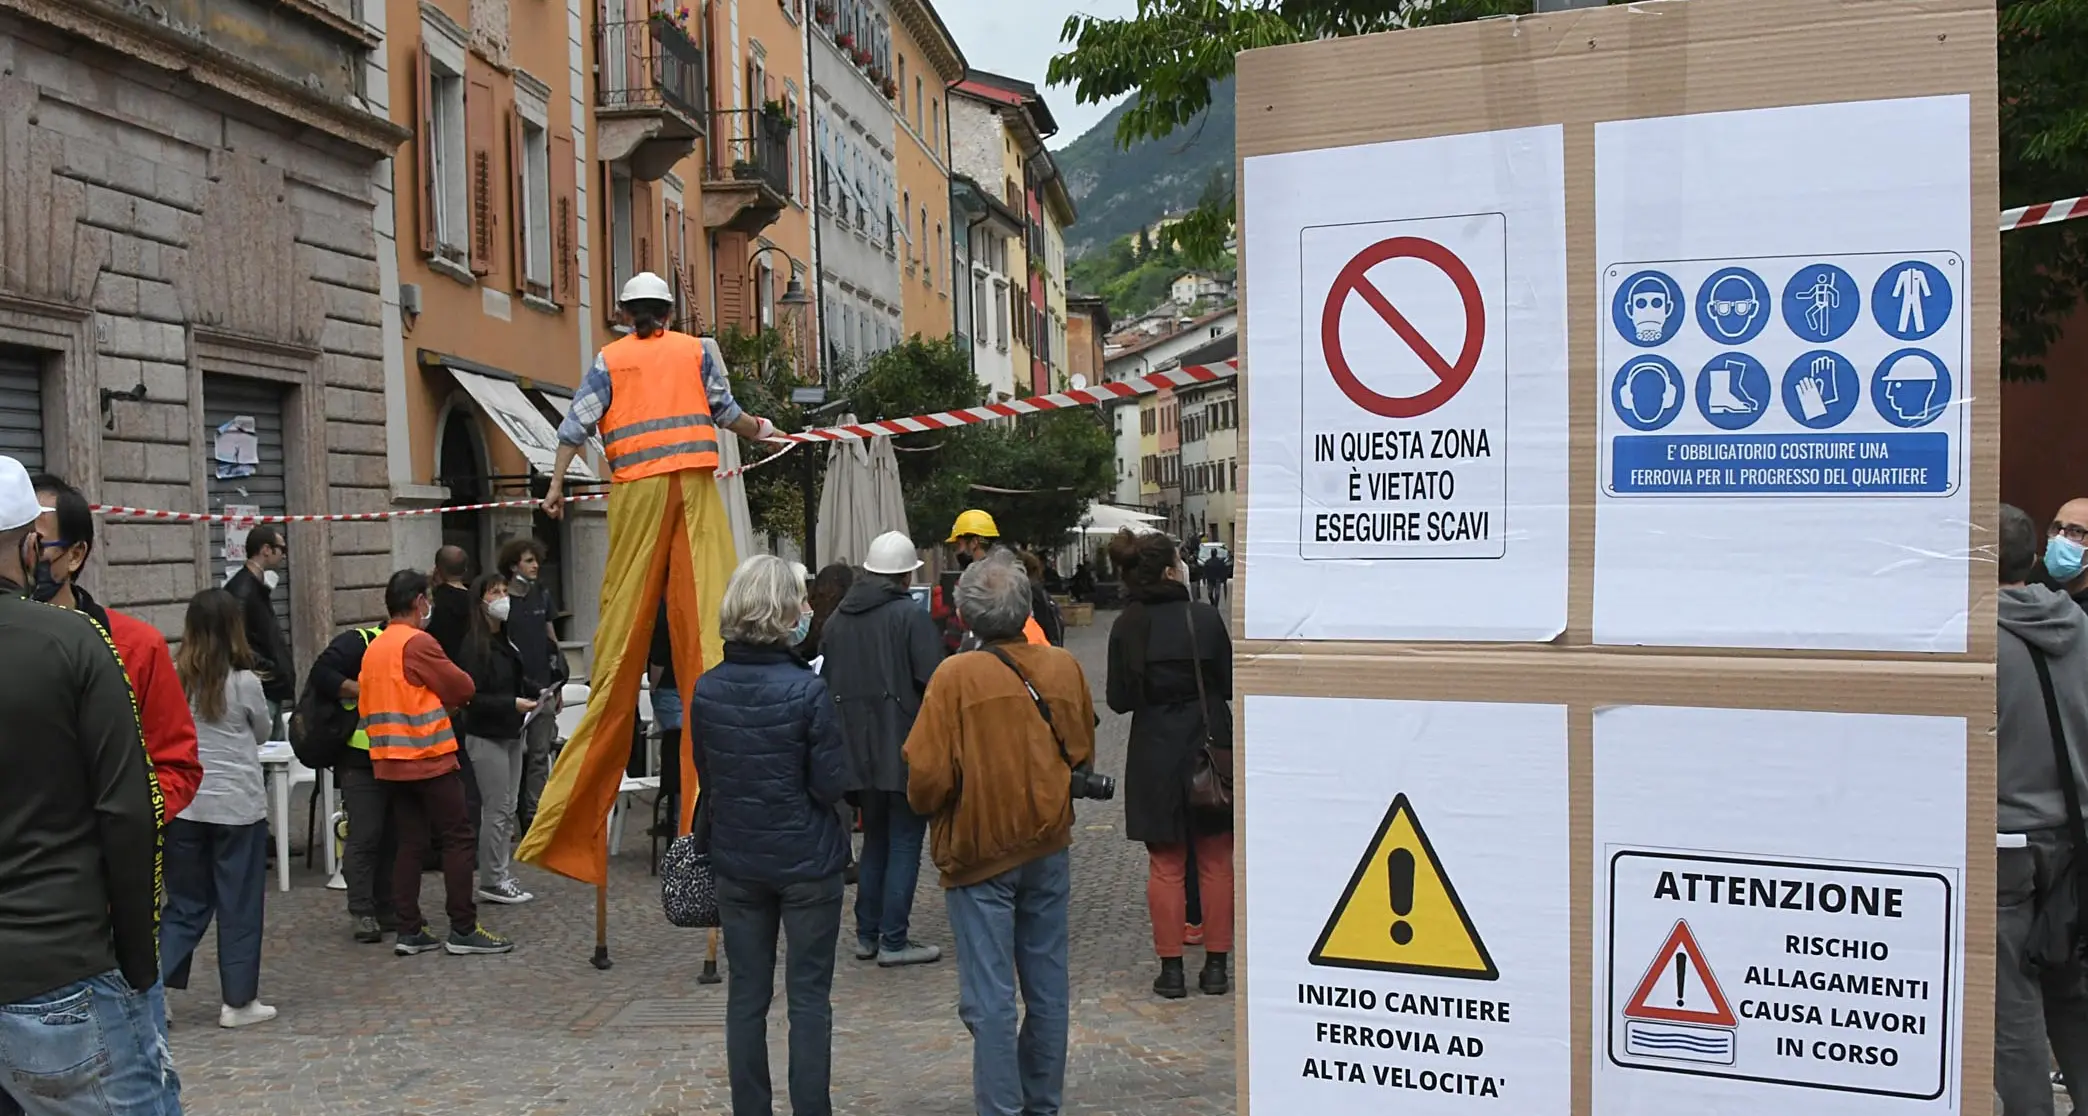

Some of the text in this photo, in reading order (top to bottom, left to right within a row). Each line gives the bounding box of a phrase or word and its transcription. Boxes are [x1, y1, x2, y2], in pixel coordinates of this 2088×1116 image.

[1316, 429, 1490, 462] IN QUESTA ZONA
[1668, 443, 1888, 460] E' OBBLIGATORIO COSTRUIRE UNA
[1350, 467, 1454, 501] È VIETATO
[1632, 468, 1927, 486] FERROVIA PER IL PROGRESSO DEL QUARTIERE
[1316, 512, 1488, 541] ESEGUIRE SCAVI
[1654, 870, 1904, 918] ATTENZIONE
[1786, 935, 1888, 960] RISCHIO
[1744, 966, 1928, 1000] ALLAGAMENTI
[1299, 984, 1509, 1022] INIZIO CANTIERE
[1740, 1000, 1925, 1034] CAUSA LAVORI
[1317, 1023, 1483, 1057] FERROVIA AD
[1777, 1038, 1898, 1066] IN CORSO
[1303, 1058, 1504, 1098] ALTA VELOCITA'
